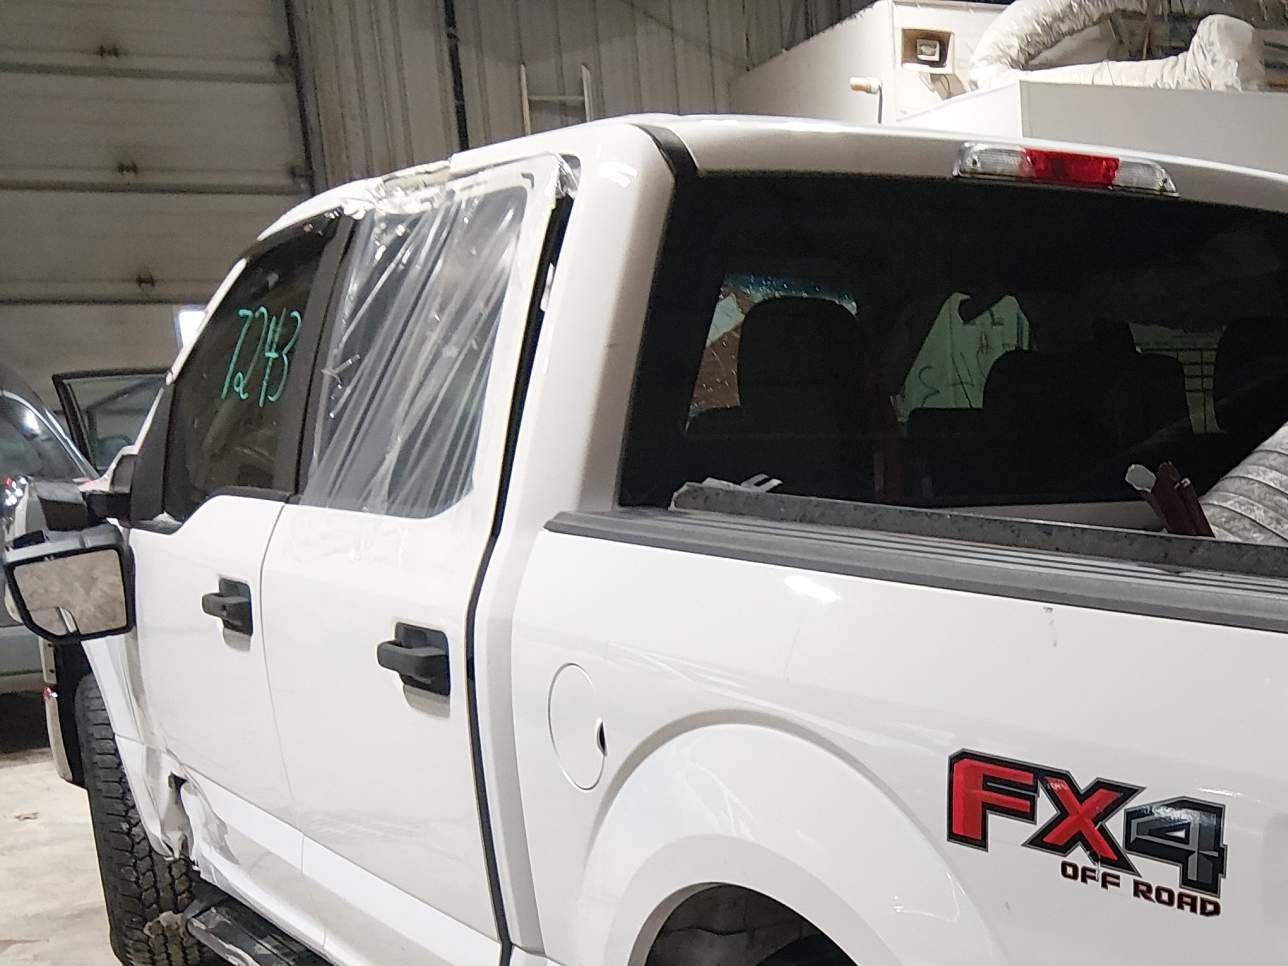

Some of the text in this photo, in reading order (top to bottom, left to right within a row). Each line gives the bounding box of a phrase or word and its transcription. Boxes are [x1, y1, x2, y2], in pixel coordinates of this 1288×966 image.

[221, 305, 302, 408] 7243
[947, 747, 1228, 898] FX4
[1060, 859, 1222, 918] OFF ROAD
